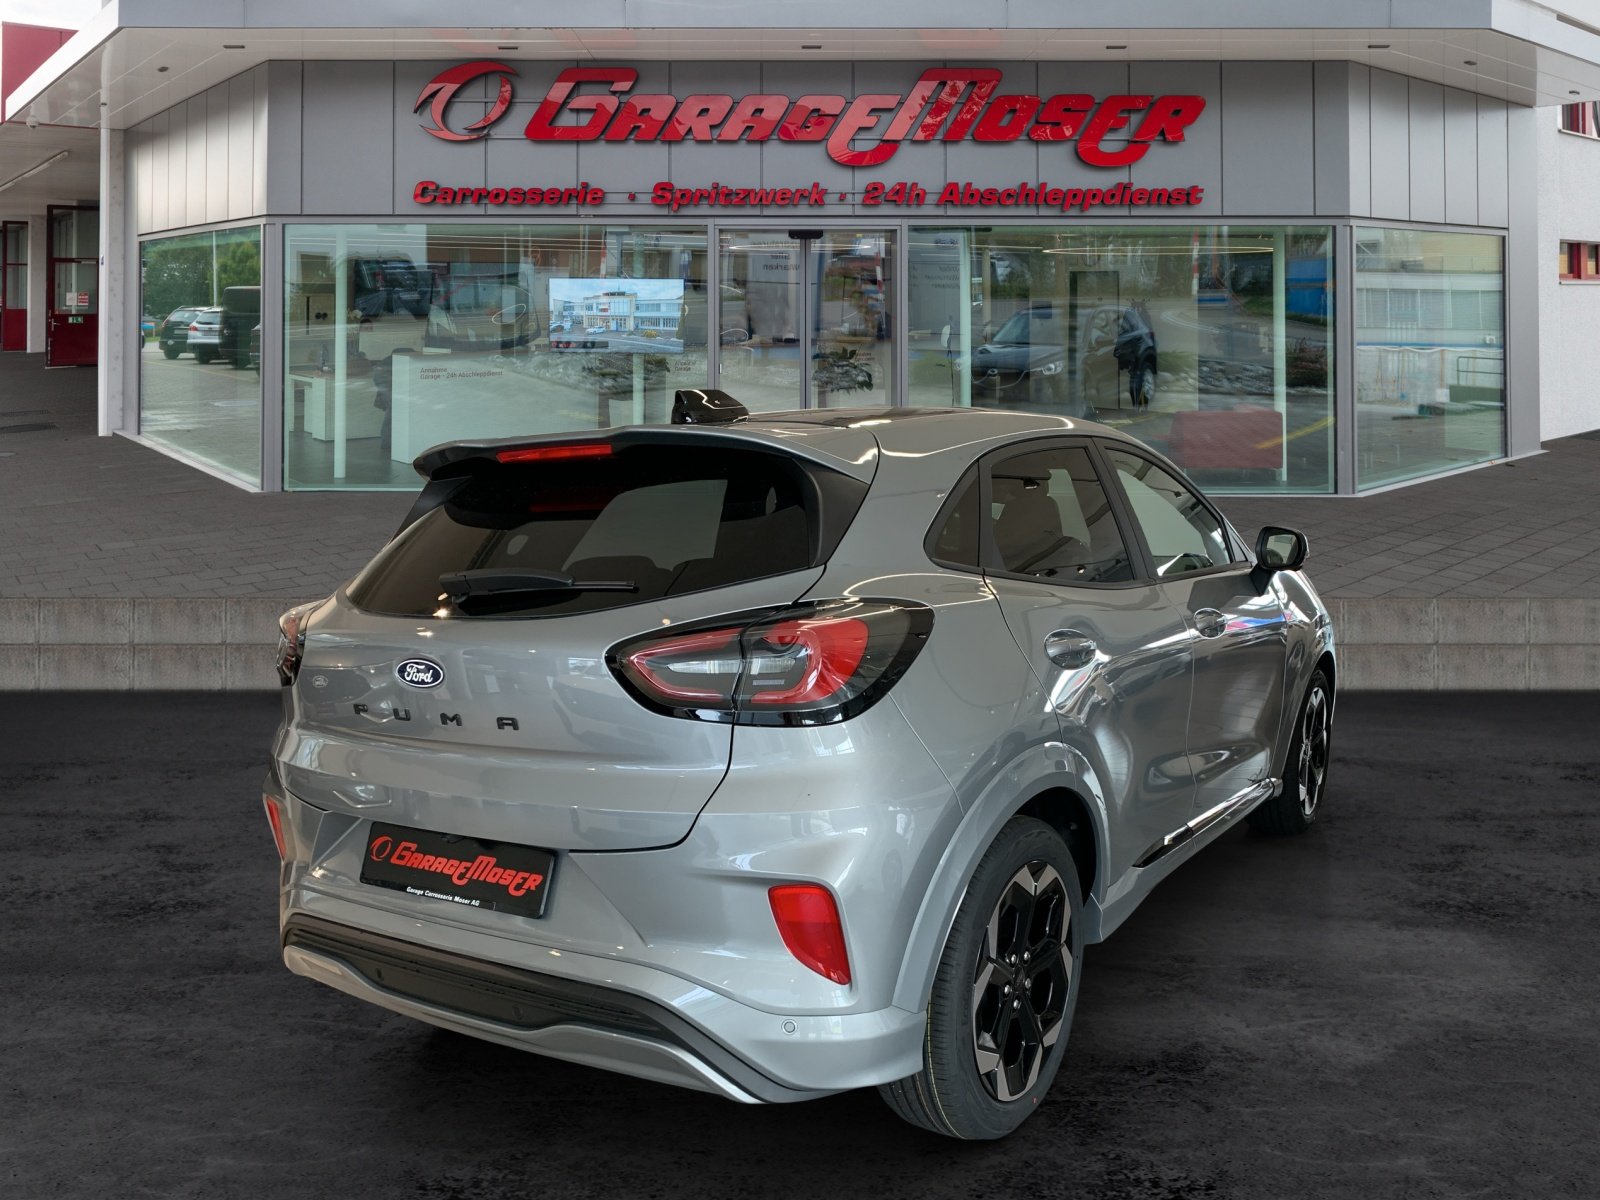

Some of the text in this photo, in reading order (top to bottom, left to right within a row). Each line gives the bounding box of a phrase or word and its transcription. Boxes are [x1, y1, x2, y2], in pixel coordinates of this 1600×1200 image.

[413, 181, 1204, 212] Carrosserie Spritzwerk 24h Abschleppdienst
[405, 663, 433, 683] Ford
[353, 703, 519, 730] PUMA
[406, 886, 424, 895] Garage
[424, 890, 453, 901] Carrosserie
[453, 896, 470, 904] Moser
